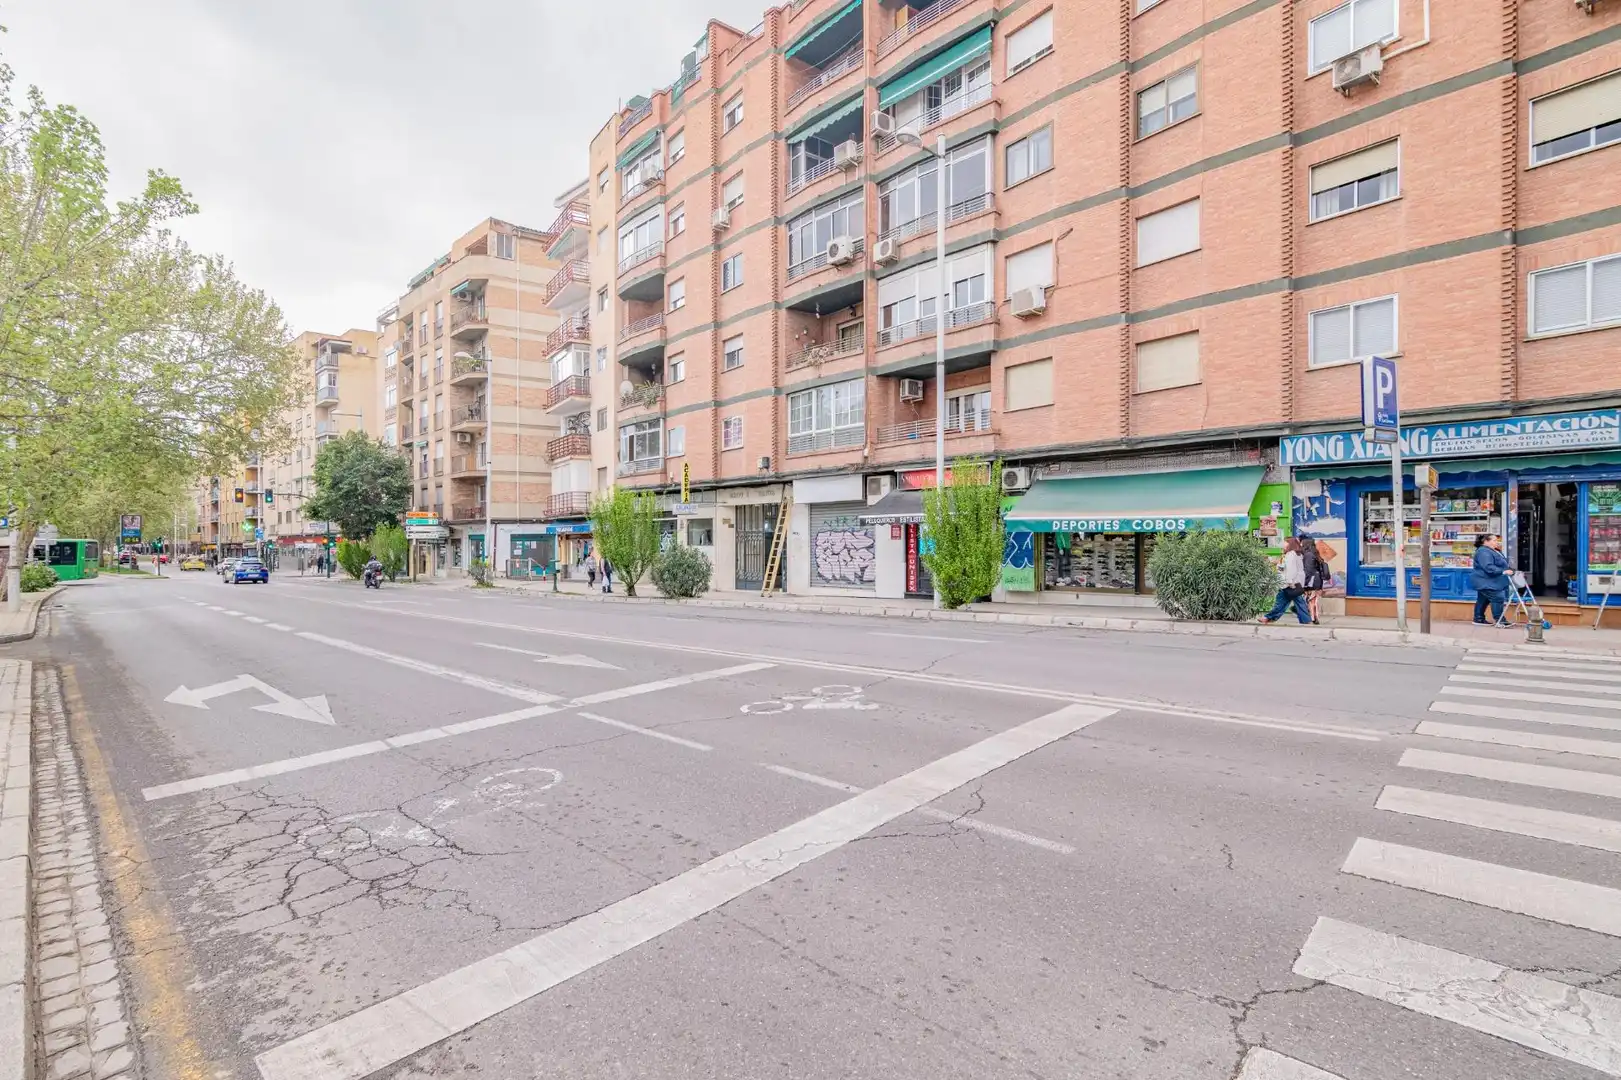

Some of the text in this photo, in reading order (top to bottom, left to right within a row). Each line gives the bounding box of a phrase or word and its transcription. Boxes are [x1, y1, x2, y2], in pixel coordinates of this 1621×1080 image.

[1376, 366, 1393, 409] P
[1432, 413, 1620, 440] ALIMENTACIÓN
[1283, 434, 1344, 464] YONG
[1052, 519, 1186, 530] DEPORTES COBOS
[908, 559, 917, 592] UNISEX
